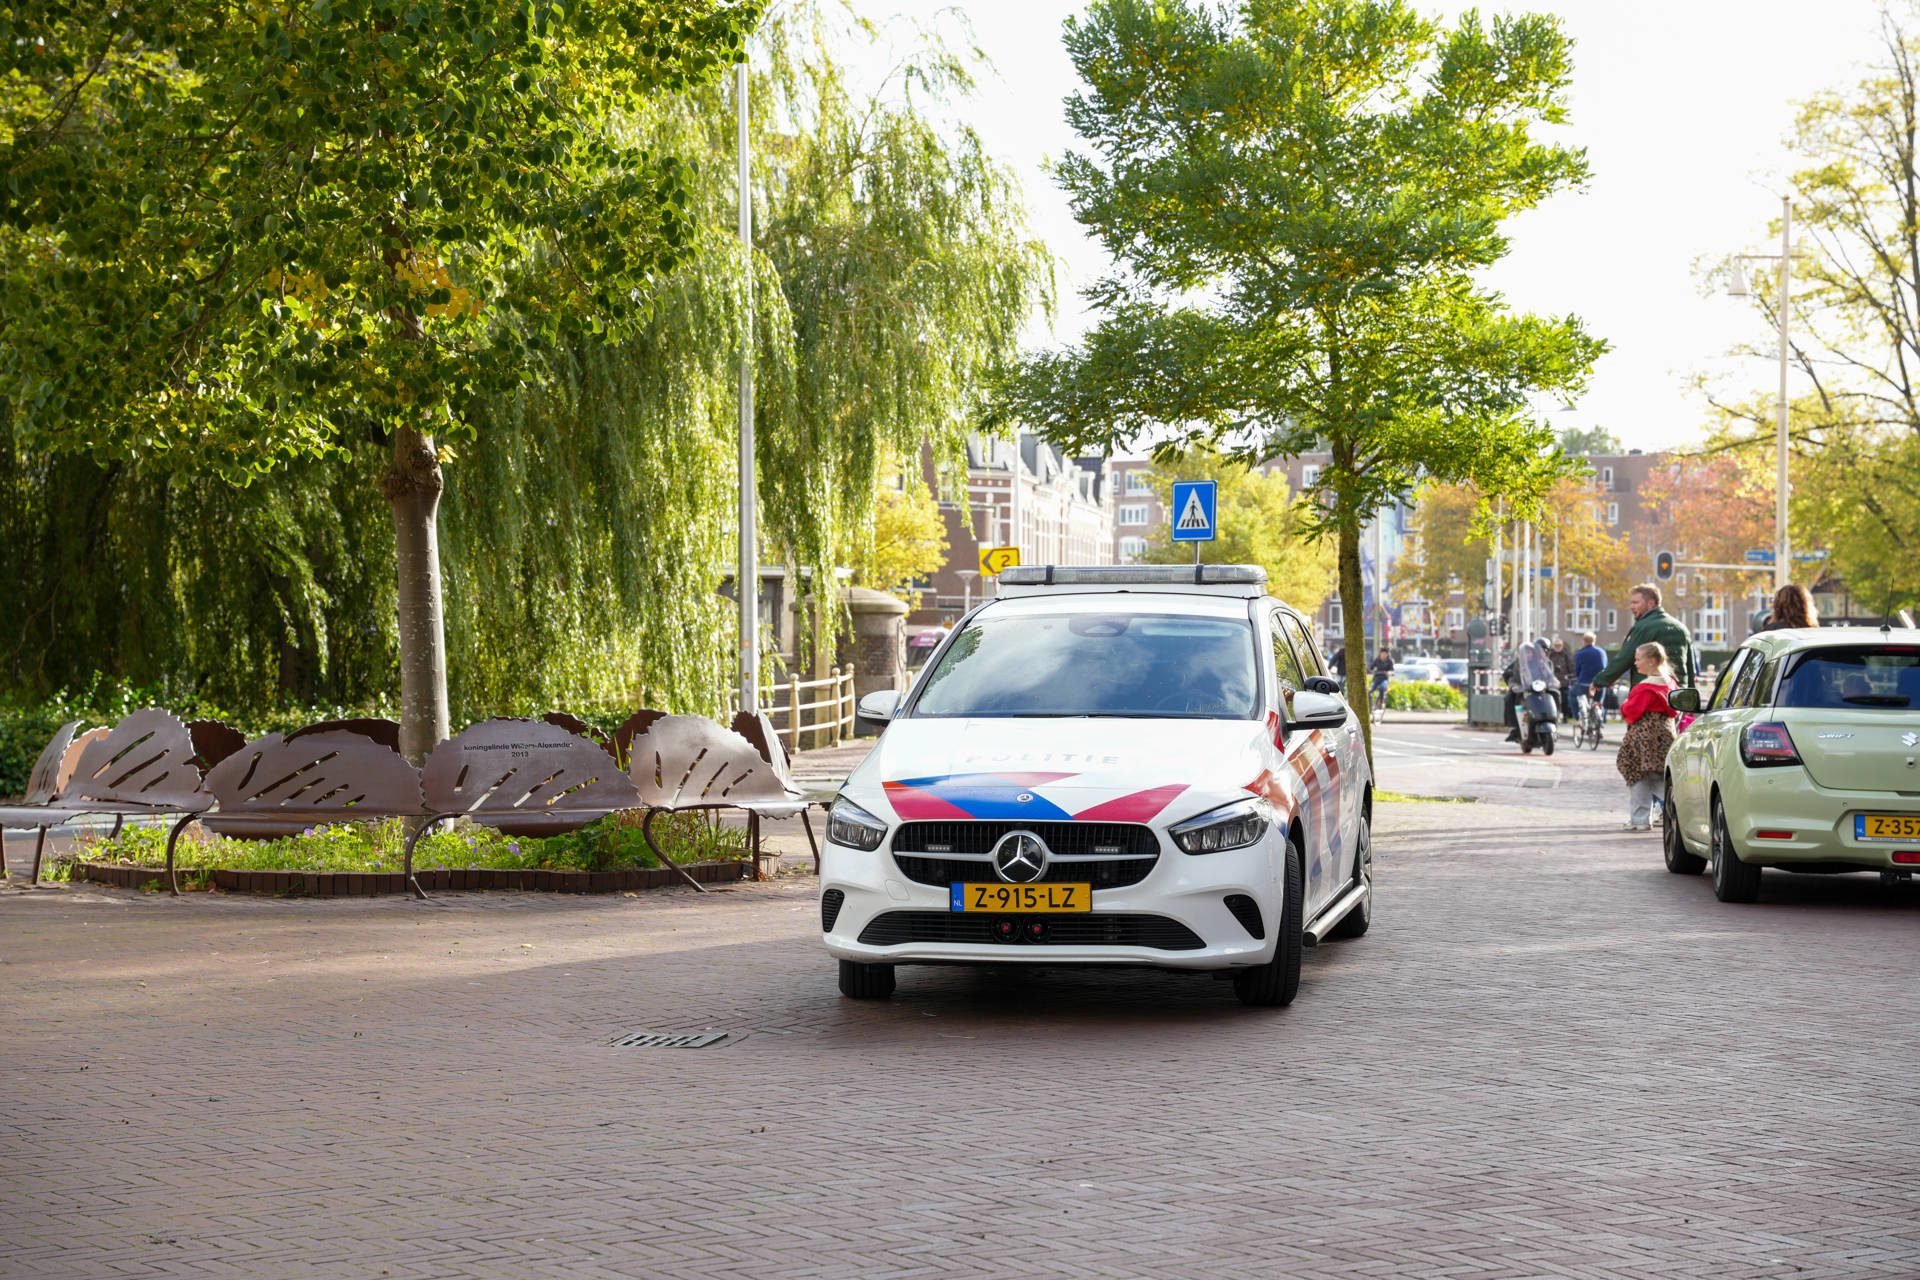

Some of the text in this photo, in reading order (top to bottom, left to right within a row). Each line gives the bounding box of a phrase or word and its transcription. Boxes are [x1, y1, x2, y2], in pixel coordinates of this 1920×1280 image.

[1001, 554, 1010, 567] 2
[965, 752, 1120, 765] POLITIE
[953, 899, 963, 907] NL
[975, 887, 1076, 909] Z-915-LZ
